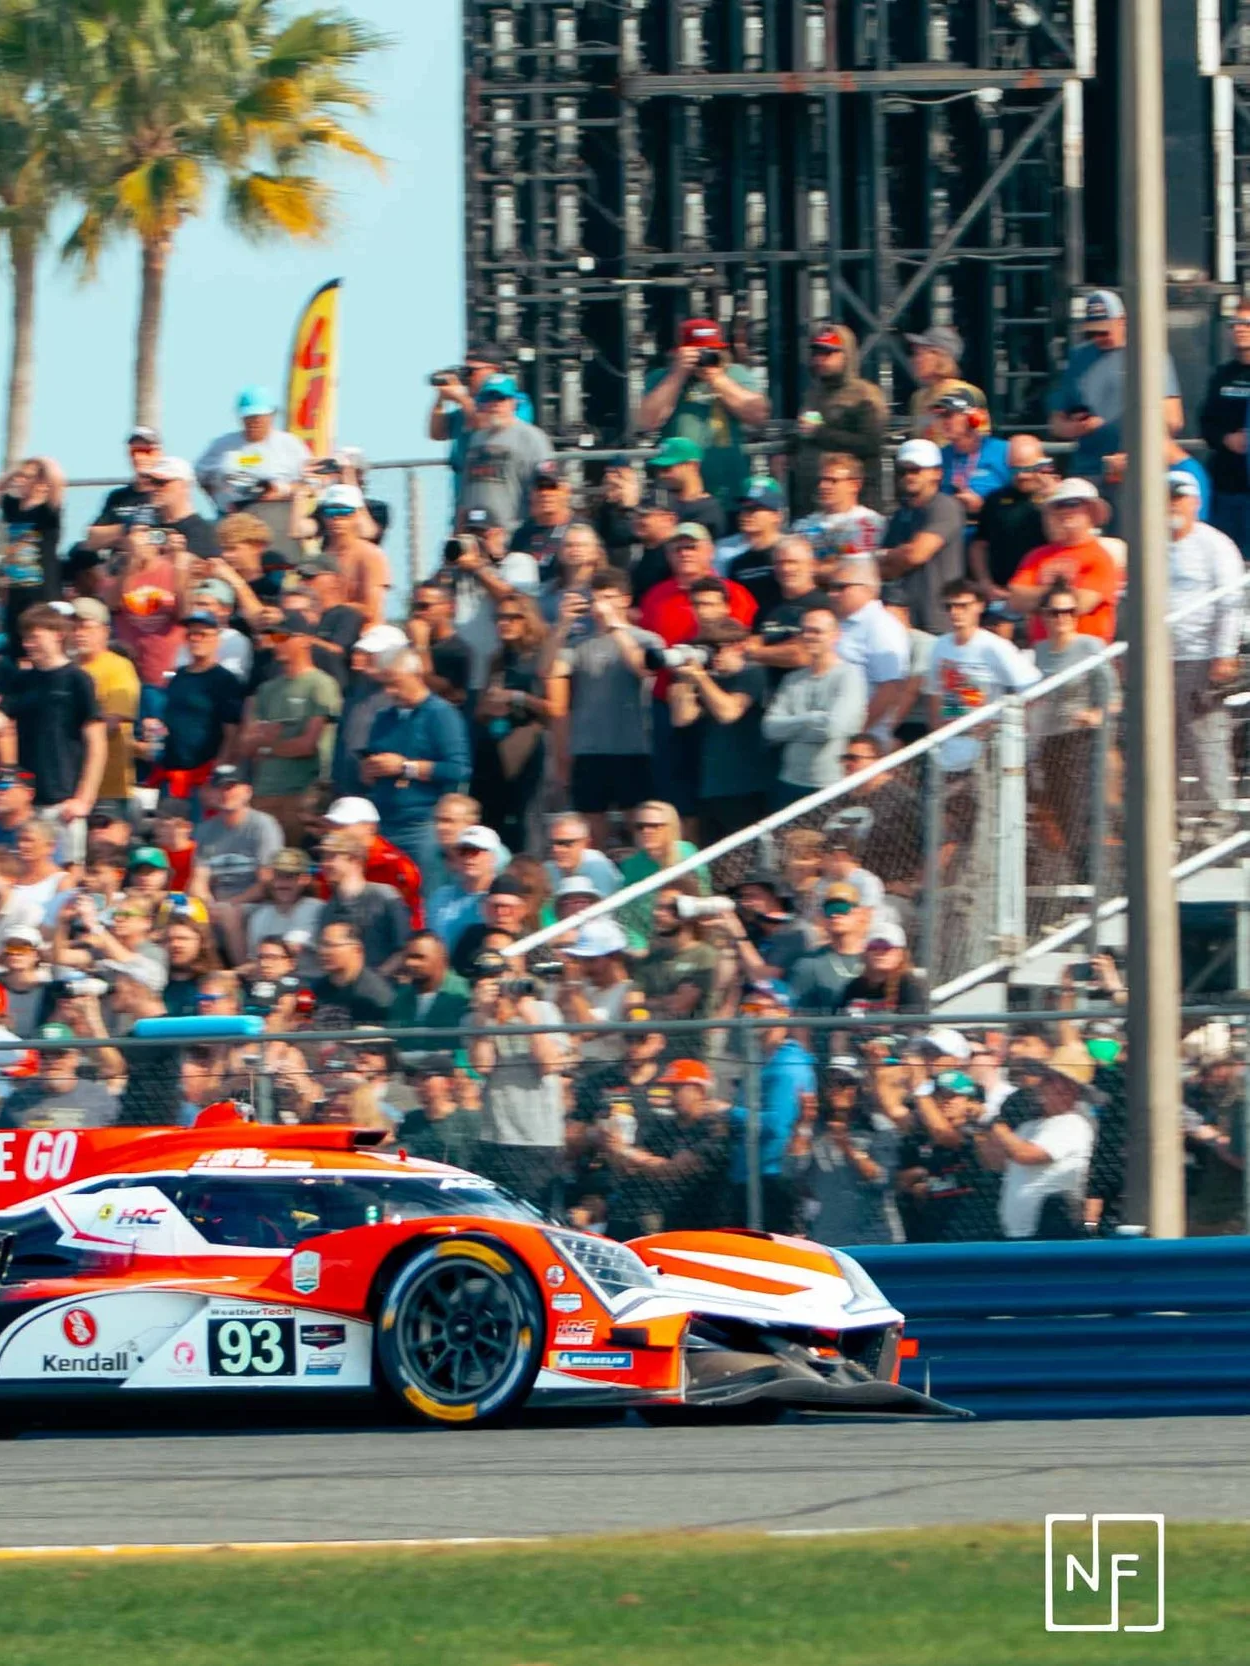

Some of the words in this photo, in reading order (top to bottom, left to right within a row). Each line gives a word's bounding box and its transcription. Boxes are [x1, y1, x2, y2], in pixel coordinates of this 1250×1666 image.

[23, 1130, 78, 1181] GO
[116, 1208, 168, 1225] HRC
[210, 1307, 292, 1316] WeatherTech
[217, 1320, 285, 1374] 93
[42, 1352, 128, 1372] Kendall
